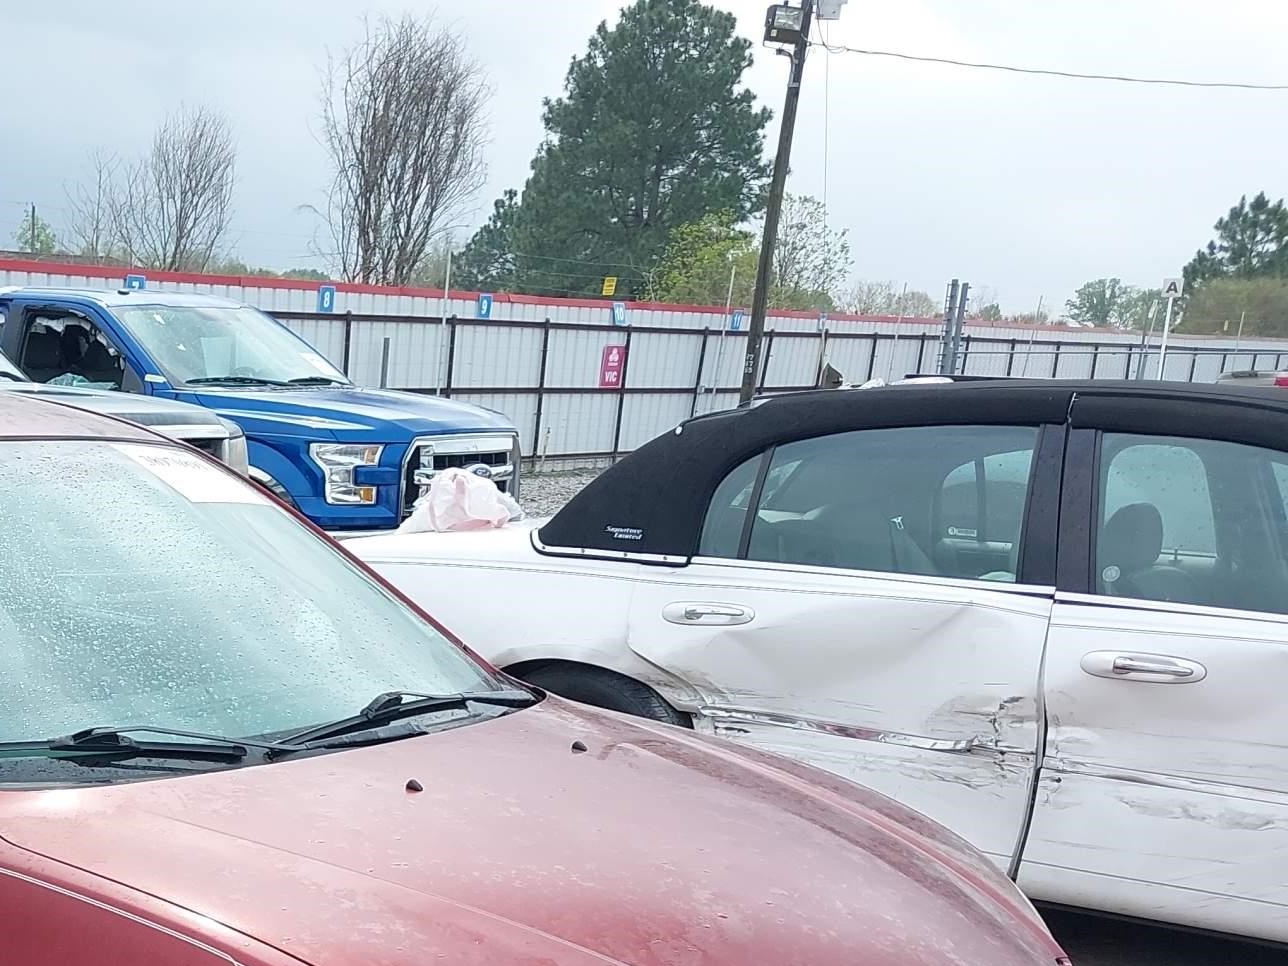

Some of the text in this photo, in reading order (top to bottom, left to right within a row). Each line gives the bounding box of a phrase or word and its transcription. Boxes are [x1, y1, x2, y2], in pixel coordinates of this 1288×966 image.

[1166, 281, 1178, 293] A
[323, 291, 331, 308] 8
[480, 299, 488, 315] 9
[615, 306, 624, 321] 10
[733, 313, 742, 328] 11
[605, 370, 618, 383] VIC
